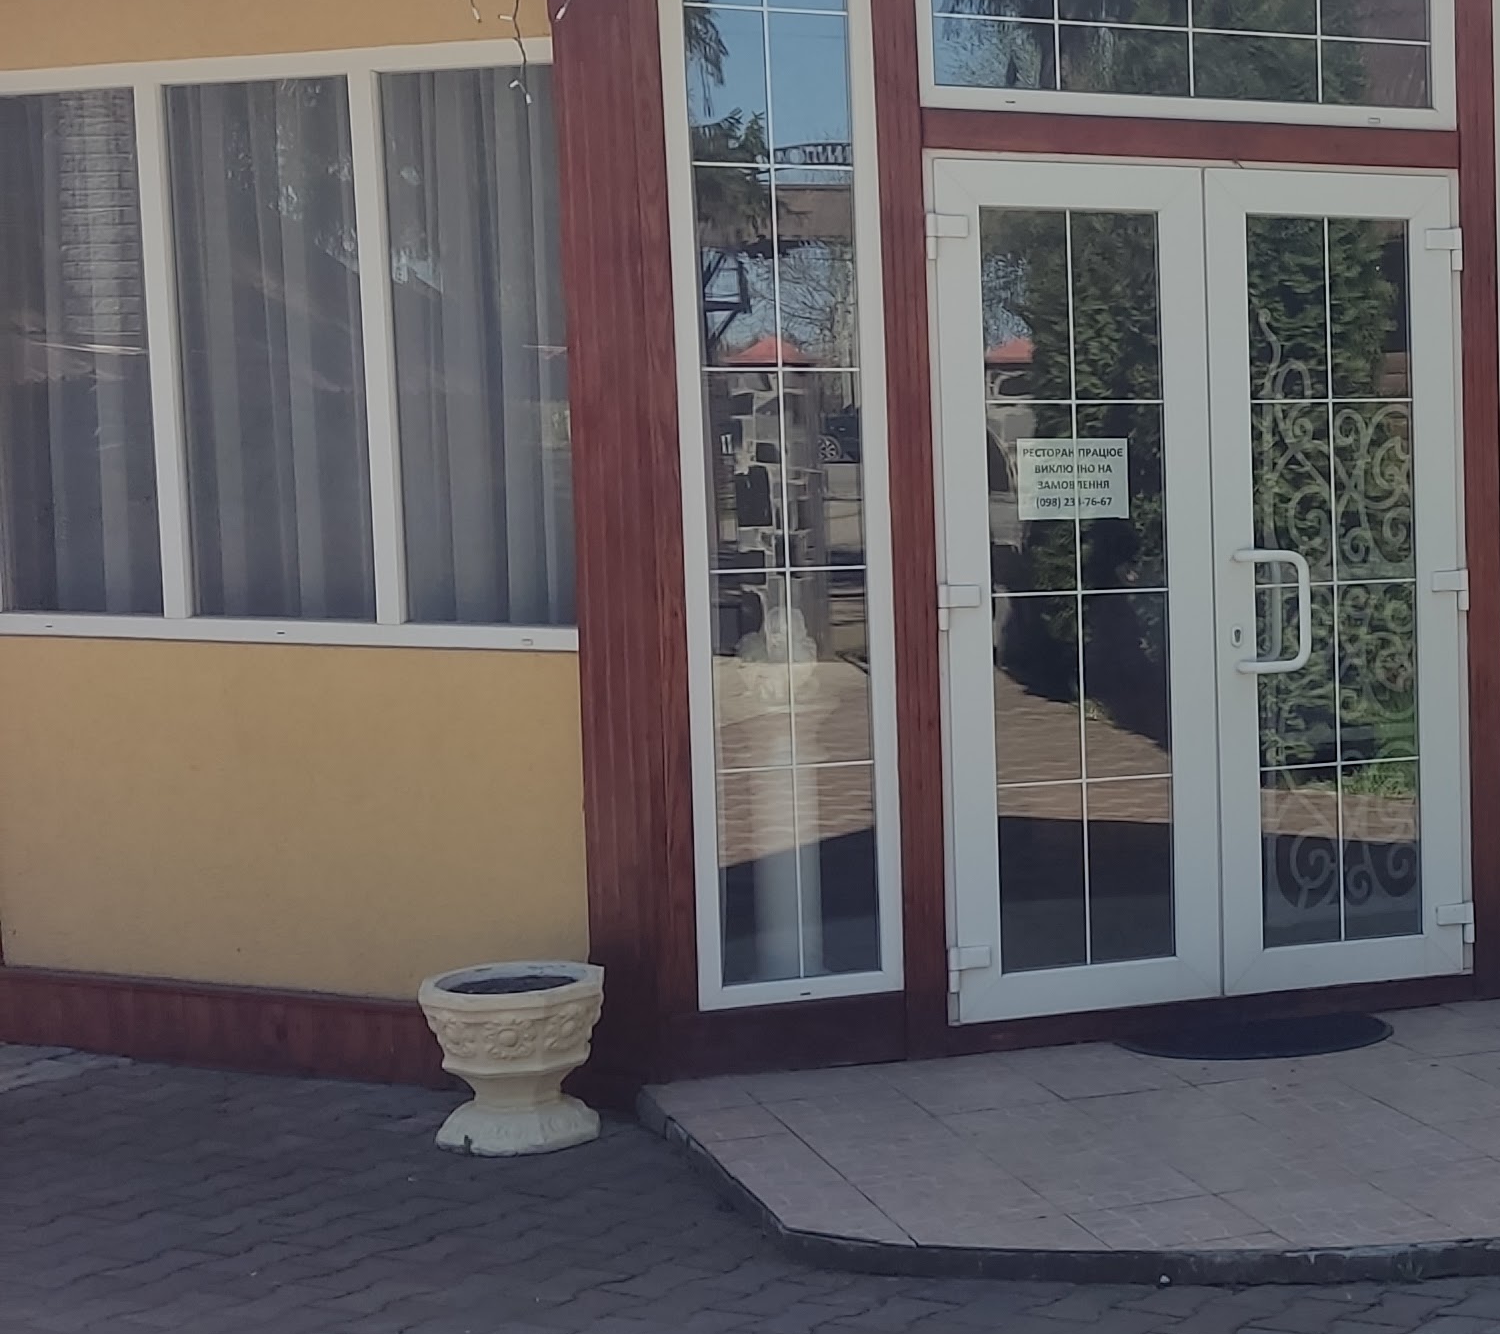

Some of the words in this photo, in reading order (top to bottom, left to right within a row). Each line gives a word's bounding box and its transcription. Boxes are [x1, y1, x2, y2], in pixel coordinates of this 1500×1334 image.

[1022, 448, 1074, 458] РЕСТОРАН
[1078, 448, 1123, 459] ПРАЦЮЄ
[1098, 464, 1113, 474] НА
[1036, 497, 1061, 509] (098)
